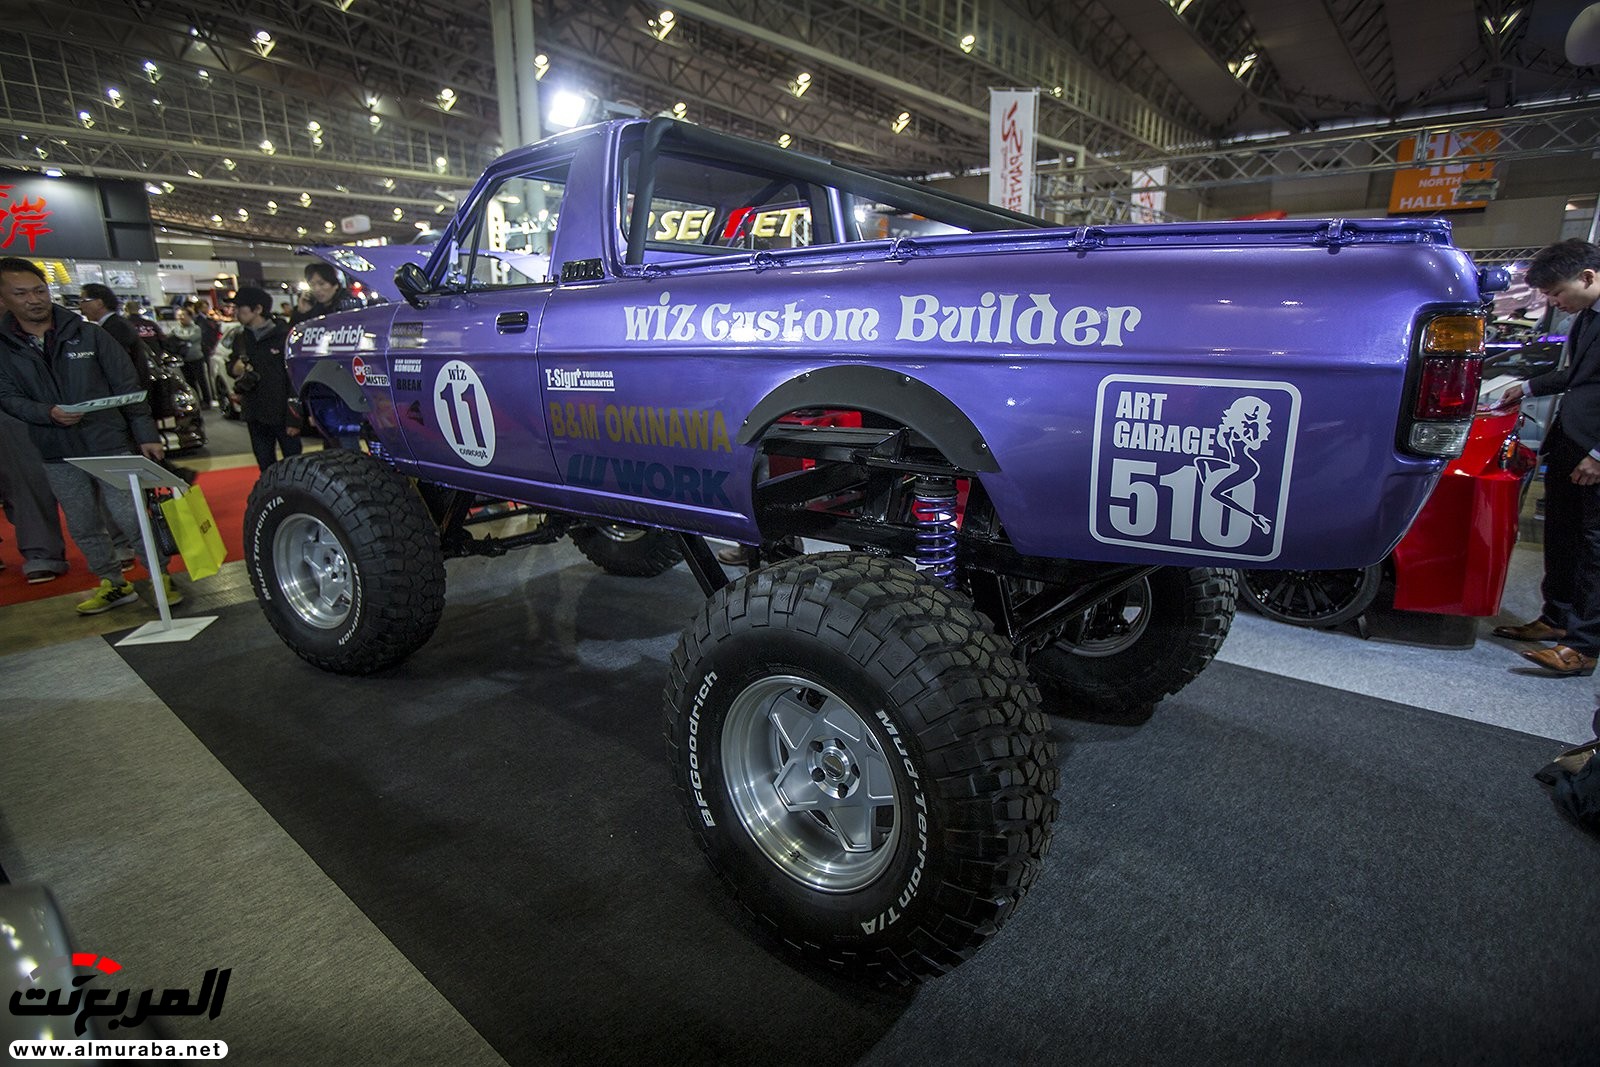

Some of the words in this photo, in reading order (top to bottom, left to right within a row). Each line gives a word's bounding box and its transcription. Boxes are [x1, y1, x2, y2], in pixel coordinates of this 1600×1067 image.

[1418, 176, 1462, 188] NORTH
[1400, 194, 1447, 209] HALL
[701, 302, 880, 342] Custom
[895, 291, 1142, 347] Builder
[303, 325, 364, 345] BFGoodrich
[394, 364, 422, 373] KOMUKAI
[582, 371, 613, 379] TOMINAGA
[396, 379, 422, 391] BREAK
[440, 383, 487, 448] 11
[1115, 391, 1168, 421] ART
[550, 402, 600, 441] B&M
[605, 404, 732, 453] OKINAWA
[1113, 420, 1216, 456] GARAGE
[609, 457, 735, 509] WORK
[266, 496, 284, 511] T/A
[1109, 458, 1256, 548] 510
[688, 670, 718, 828] BFGoodrich
[860, 905, 901, 936] T/A
